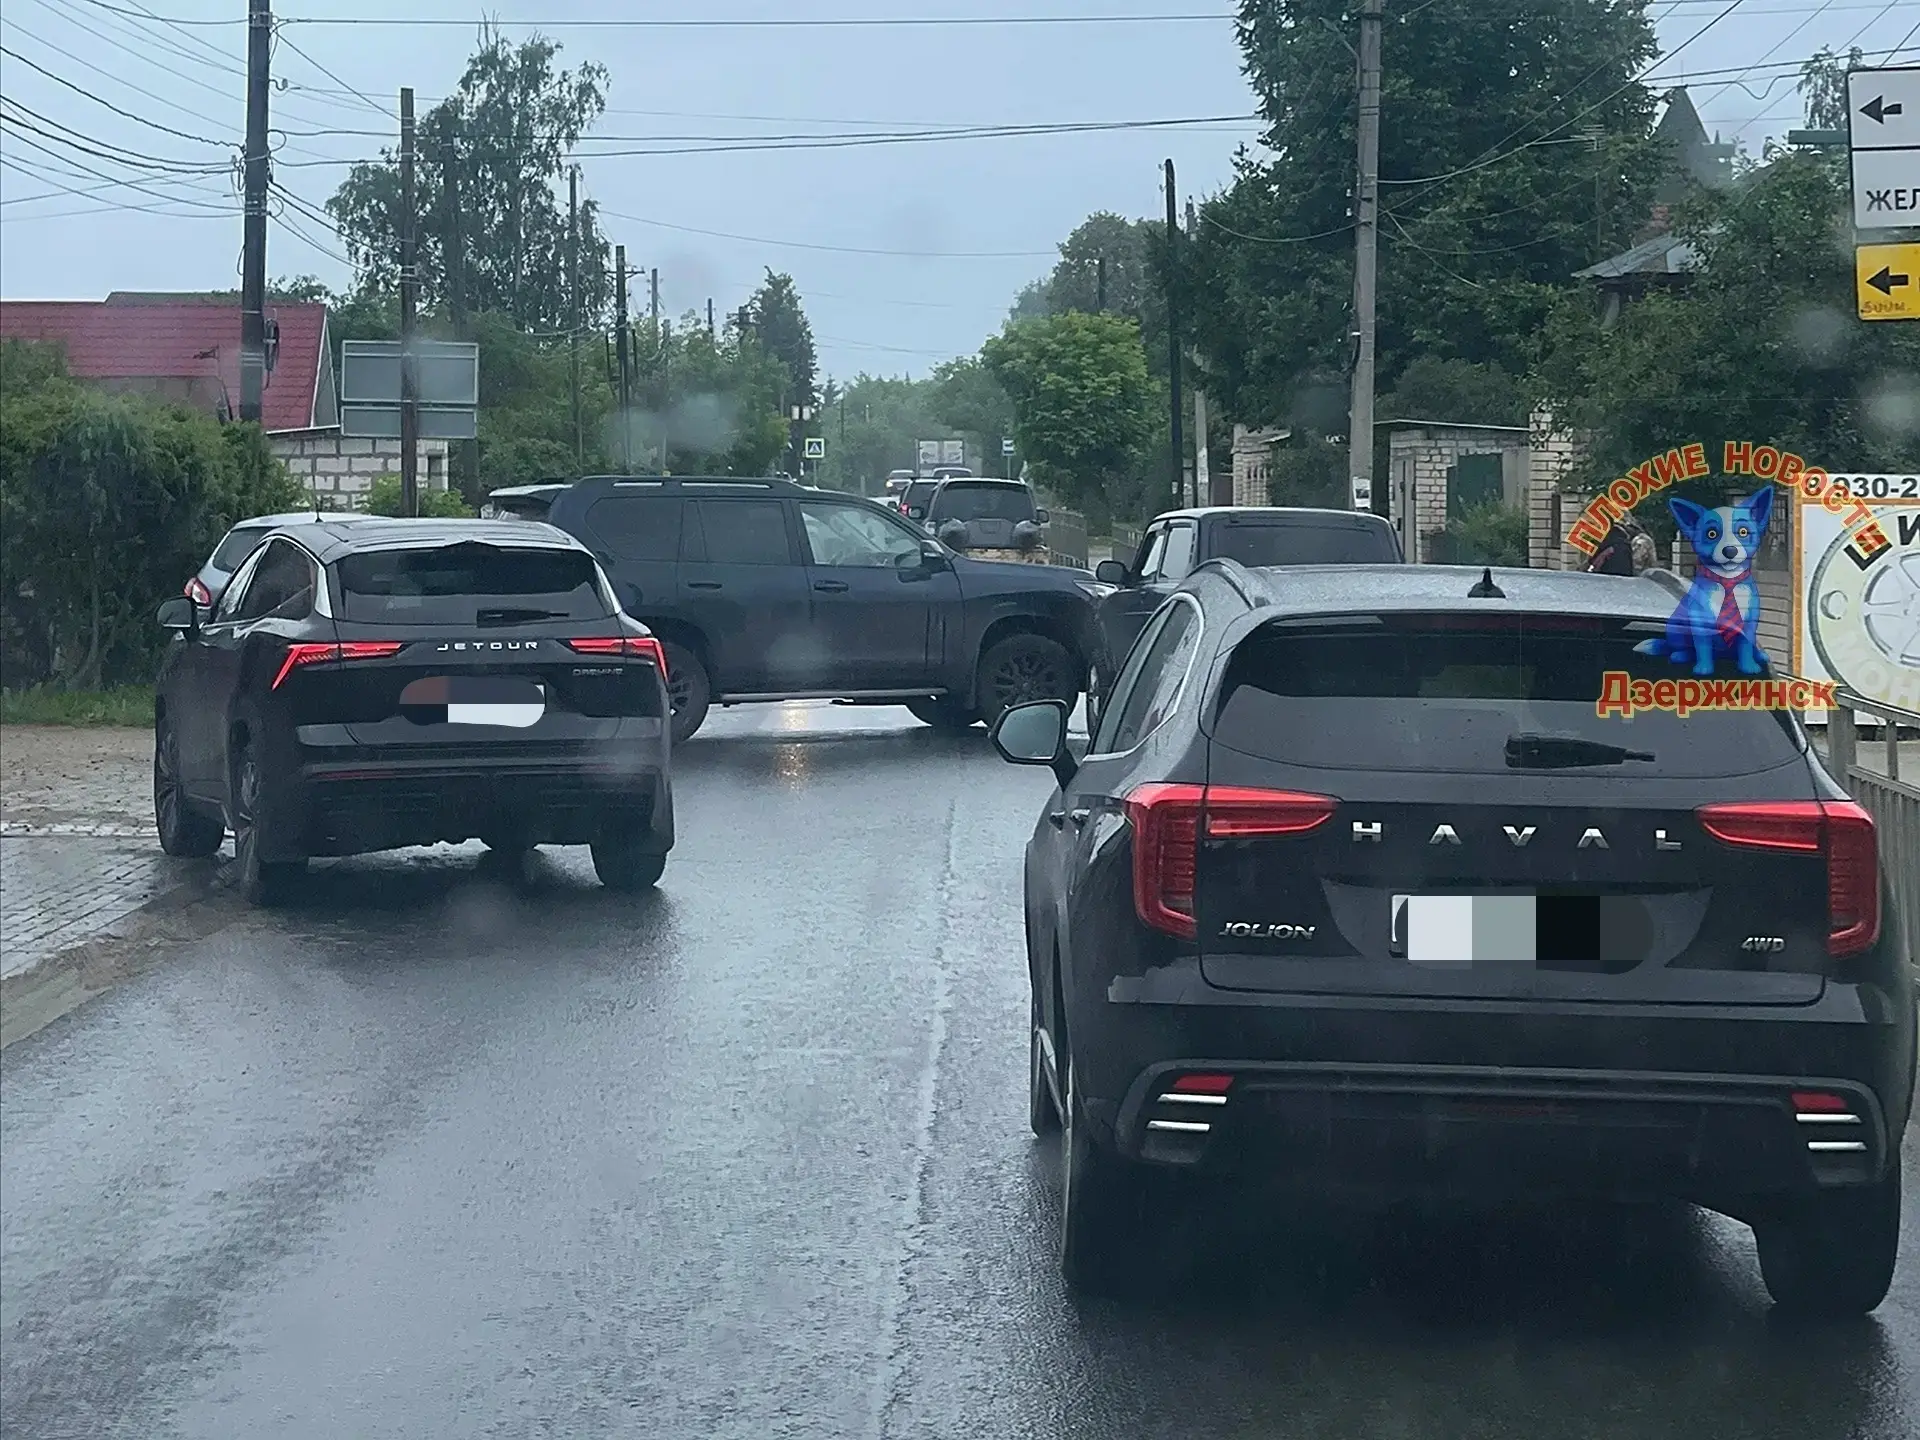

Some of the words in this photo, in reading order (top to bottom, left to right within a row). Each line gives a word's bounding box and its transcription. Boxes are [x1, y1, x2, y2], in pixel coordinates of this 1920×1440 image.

[437, 641, 538, 651] JETOUR
[1352, 821, 1683, 851] HAVAL
[1219, 922, 1316, 939] JOLION
[1741, 937, 1785, 952] 4WD
